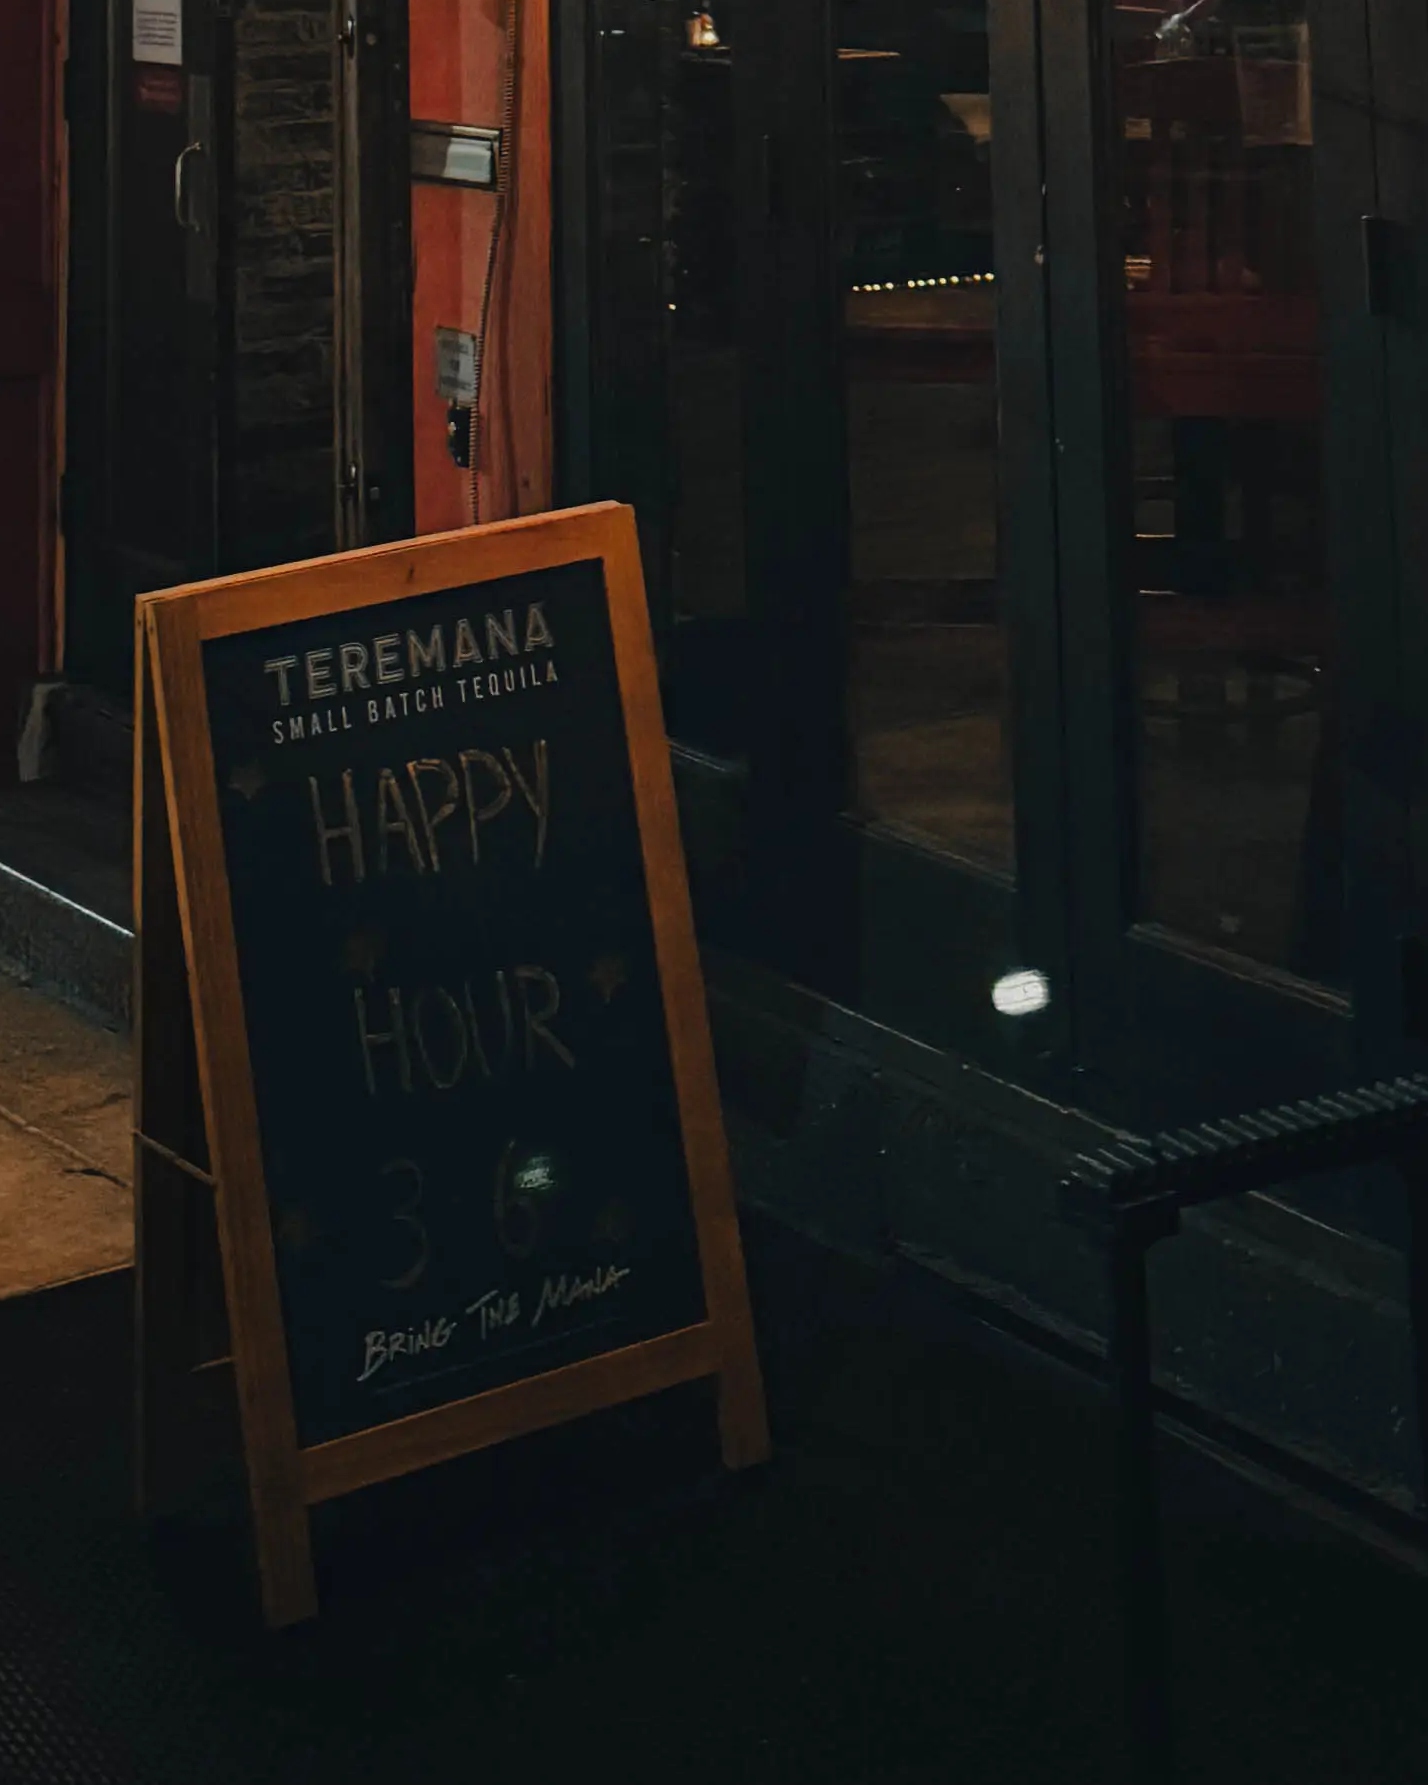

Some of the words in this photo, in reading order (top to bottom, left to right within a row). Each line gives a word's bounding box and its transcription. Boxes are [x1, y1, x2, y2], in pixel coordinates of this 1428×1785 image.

[263, 600, 556, 707] TEREMANA
[271, 705, 353, 745] SMALL
[367, 685, 445, 724] BATCH
[456, 659, 560, 704] TEQUILA
[307, 738, 550, 887] HAPPY
[353, 964, 577, 1097] HOUR
[465, 1289, 522, 1341] THE
[531, 1264, 632, 1328] MANA
